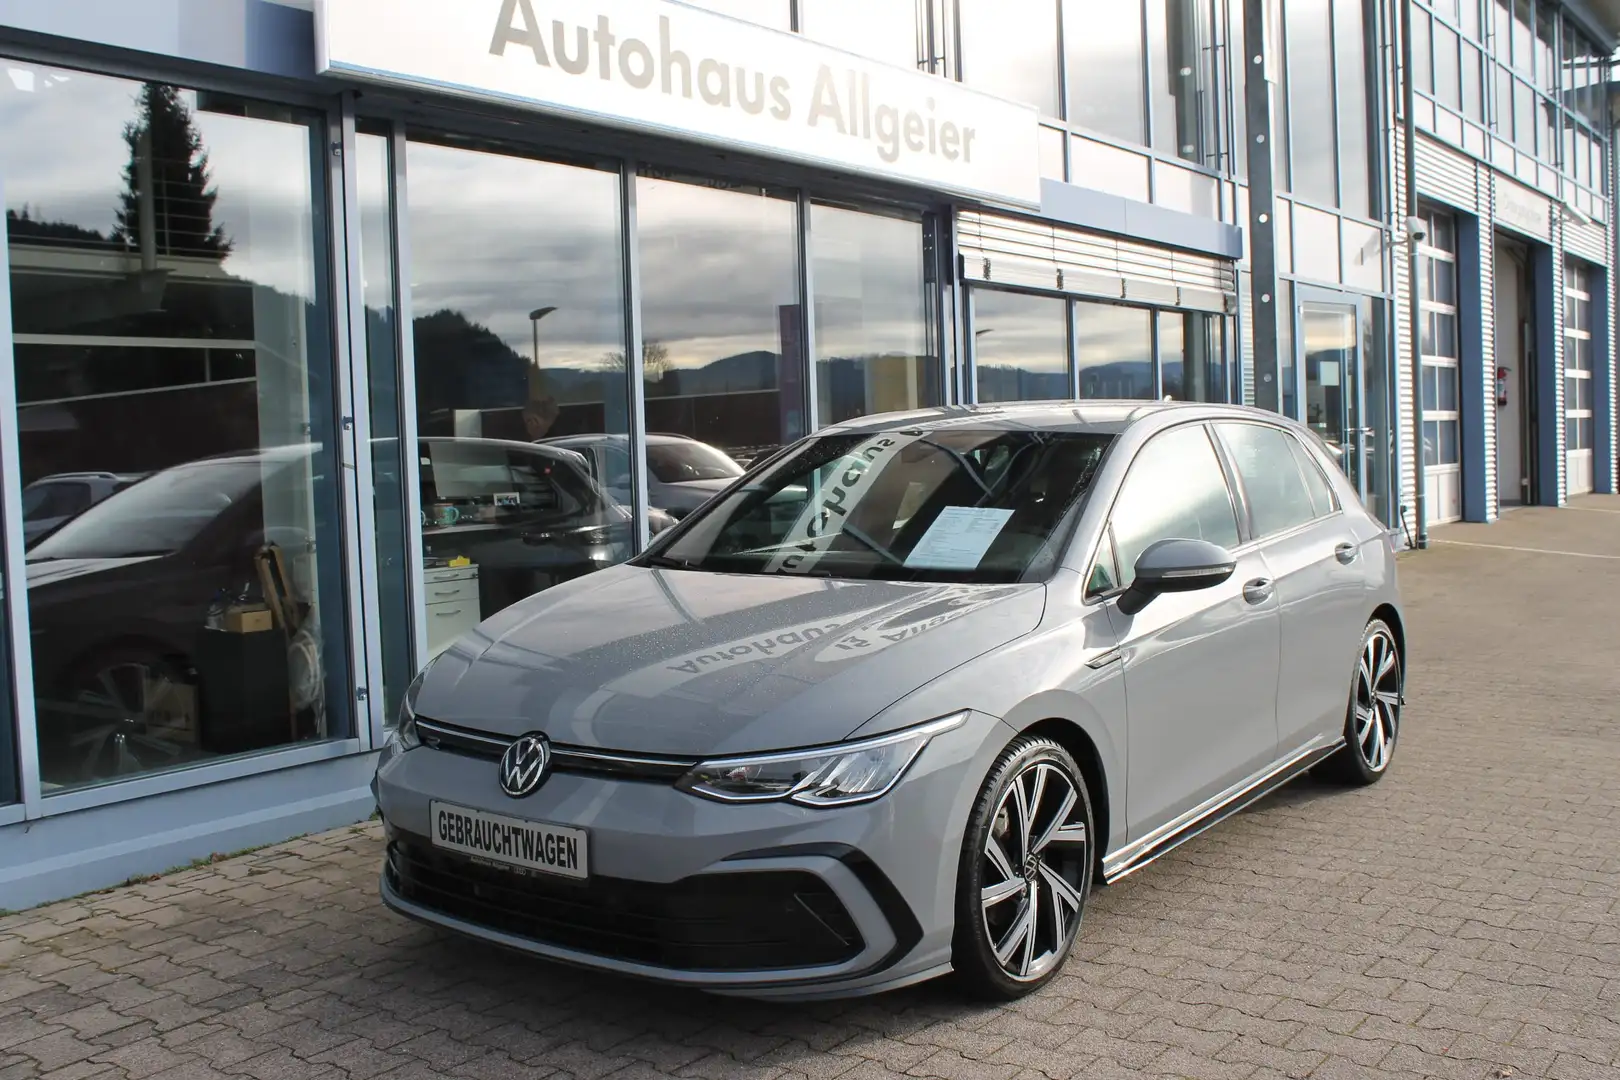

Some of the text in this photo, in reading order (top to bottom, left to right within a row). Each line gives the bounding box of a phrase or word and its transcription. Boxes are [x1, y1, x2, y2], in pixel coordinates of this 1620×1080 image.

[489, 0, 976, 164] Autohaus Allgeier
[438, 810, 578, 869] GEBRAUCHTWAGEN
